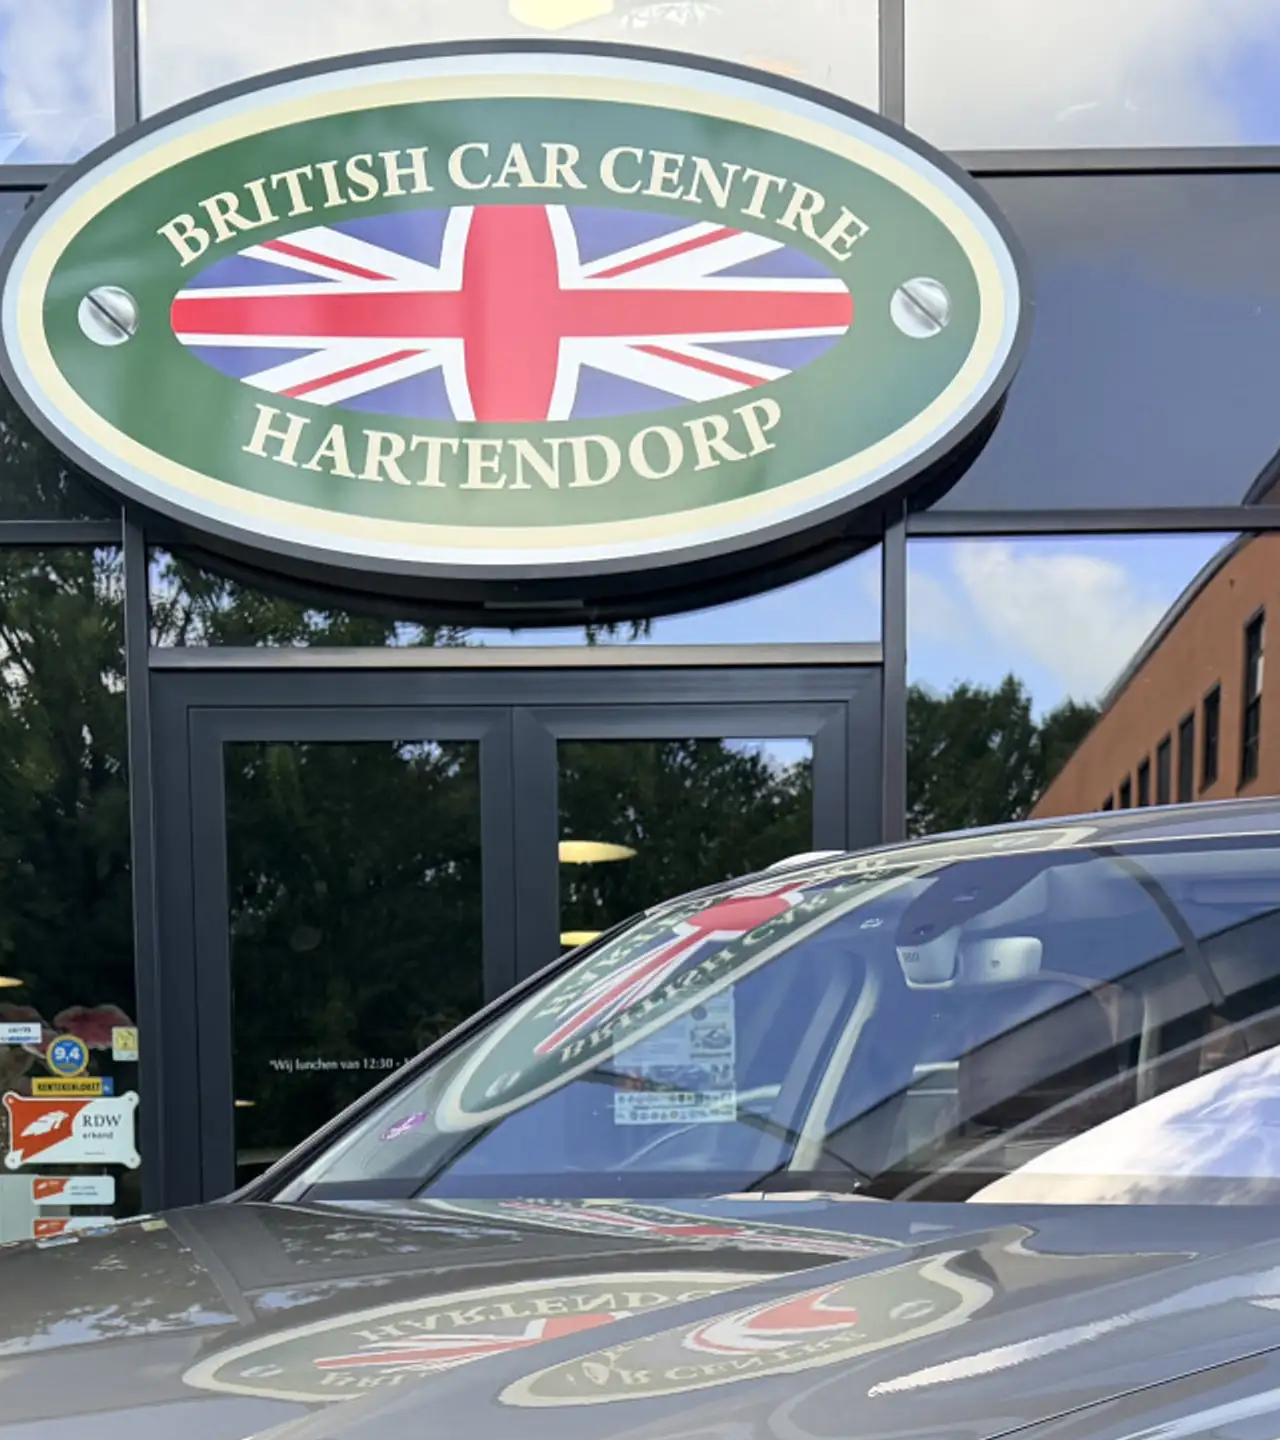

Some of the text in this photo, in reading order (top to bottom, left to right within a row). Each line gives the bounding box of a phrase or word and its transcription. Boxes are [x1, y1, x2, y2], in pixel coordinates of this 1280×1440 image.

[156, 141, 870, 267] BRITISH CAR CENTRE
[242, 397, 782, 491] HARTENDORP
[340, 1059, 360, 1069] van
[363, 1058, 393, 1069] 12:30
[82, 1113, 122, 1128] RDW
